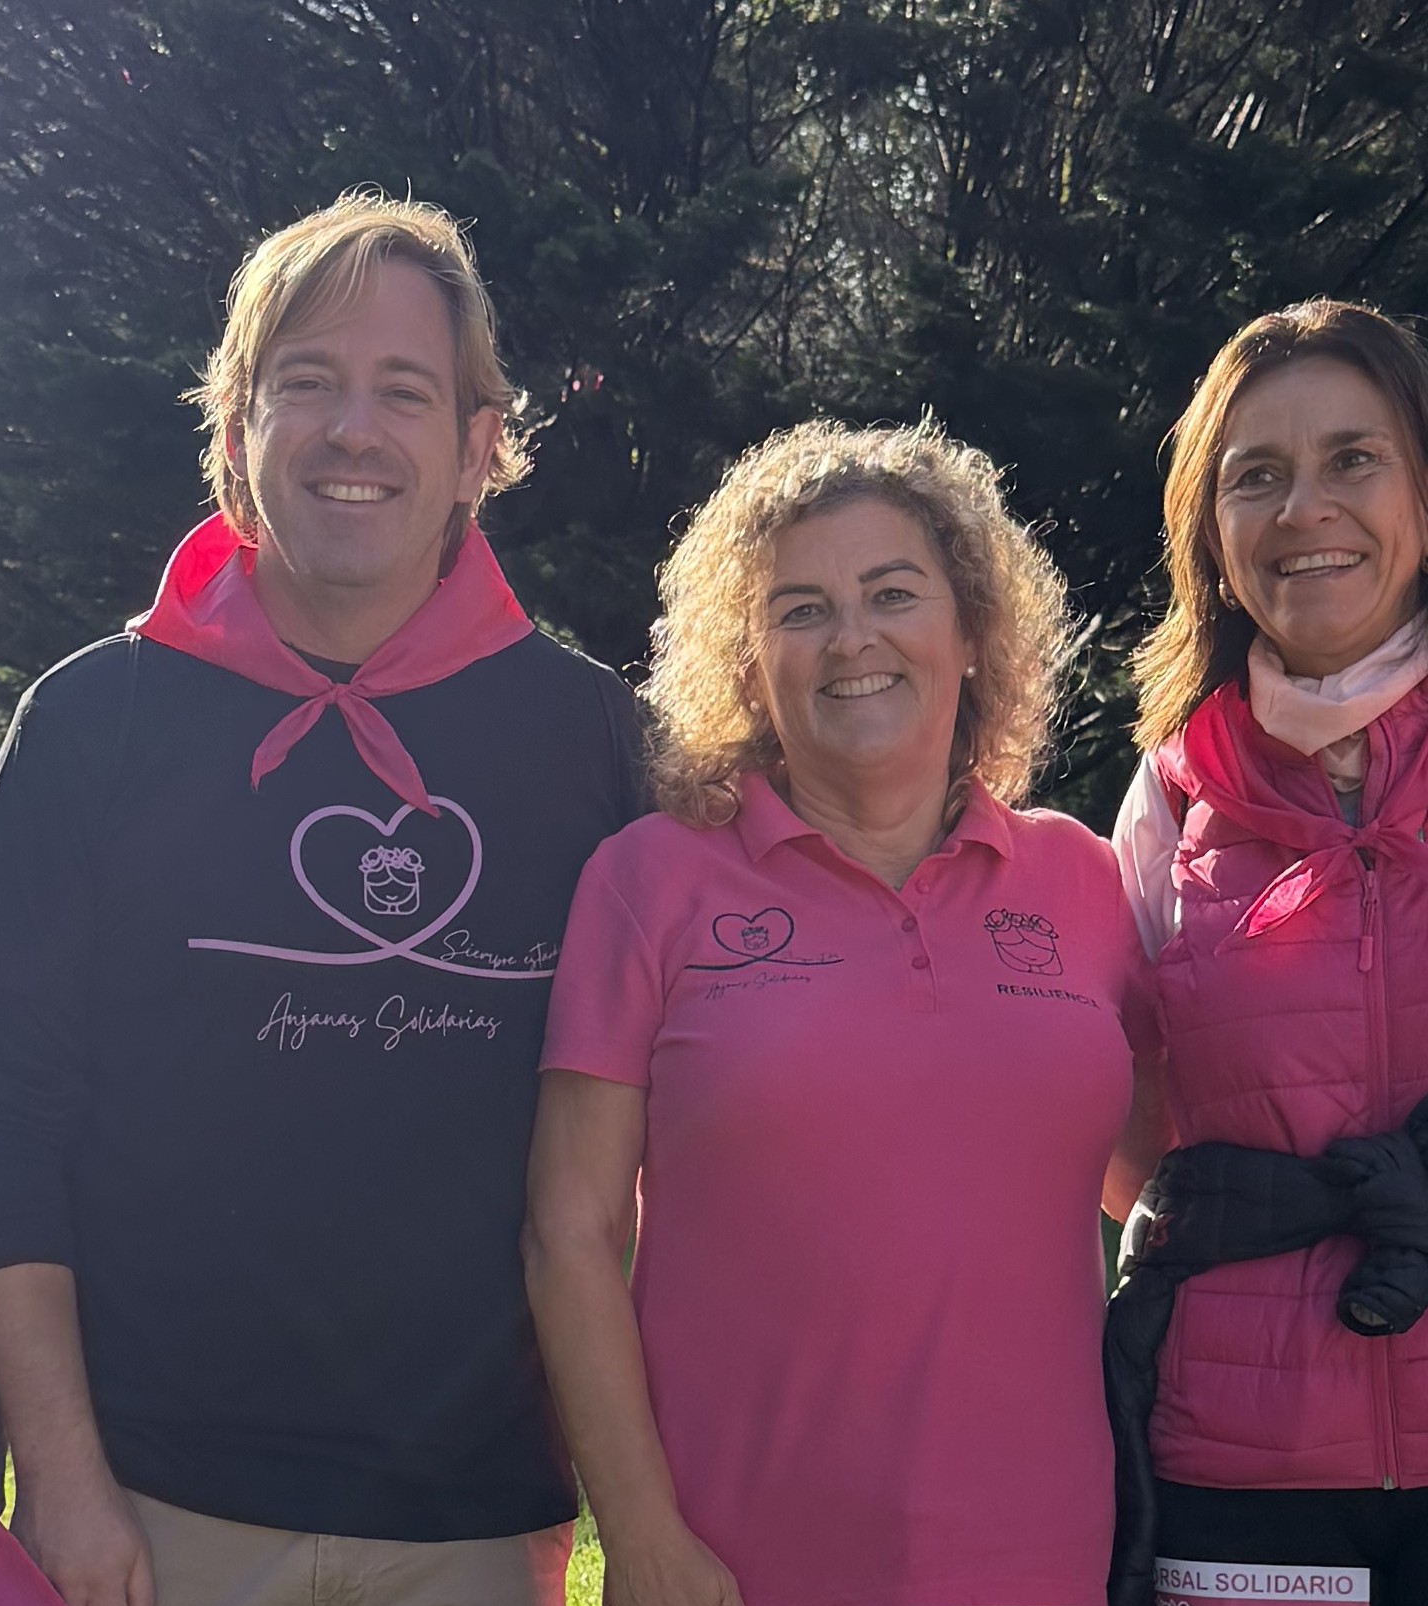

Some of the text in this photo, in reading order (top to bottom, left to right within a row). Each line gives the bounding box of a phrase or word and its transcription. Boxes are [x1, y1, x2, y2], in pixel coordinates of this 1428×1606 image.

[440, 929, 517, 970] Siempre
[256, 992, 502, 1052] Anjanas Solidarias
[1215, 1573, 1354, 1596] SOLIDARIO
